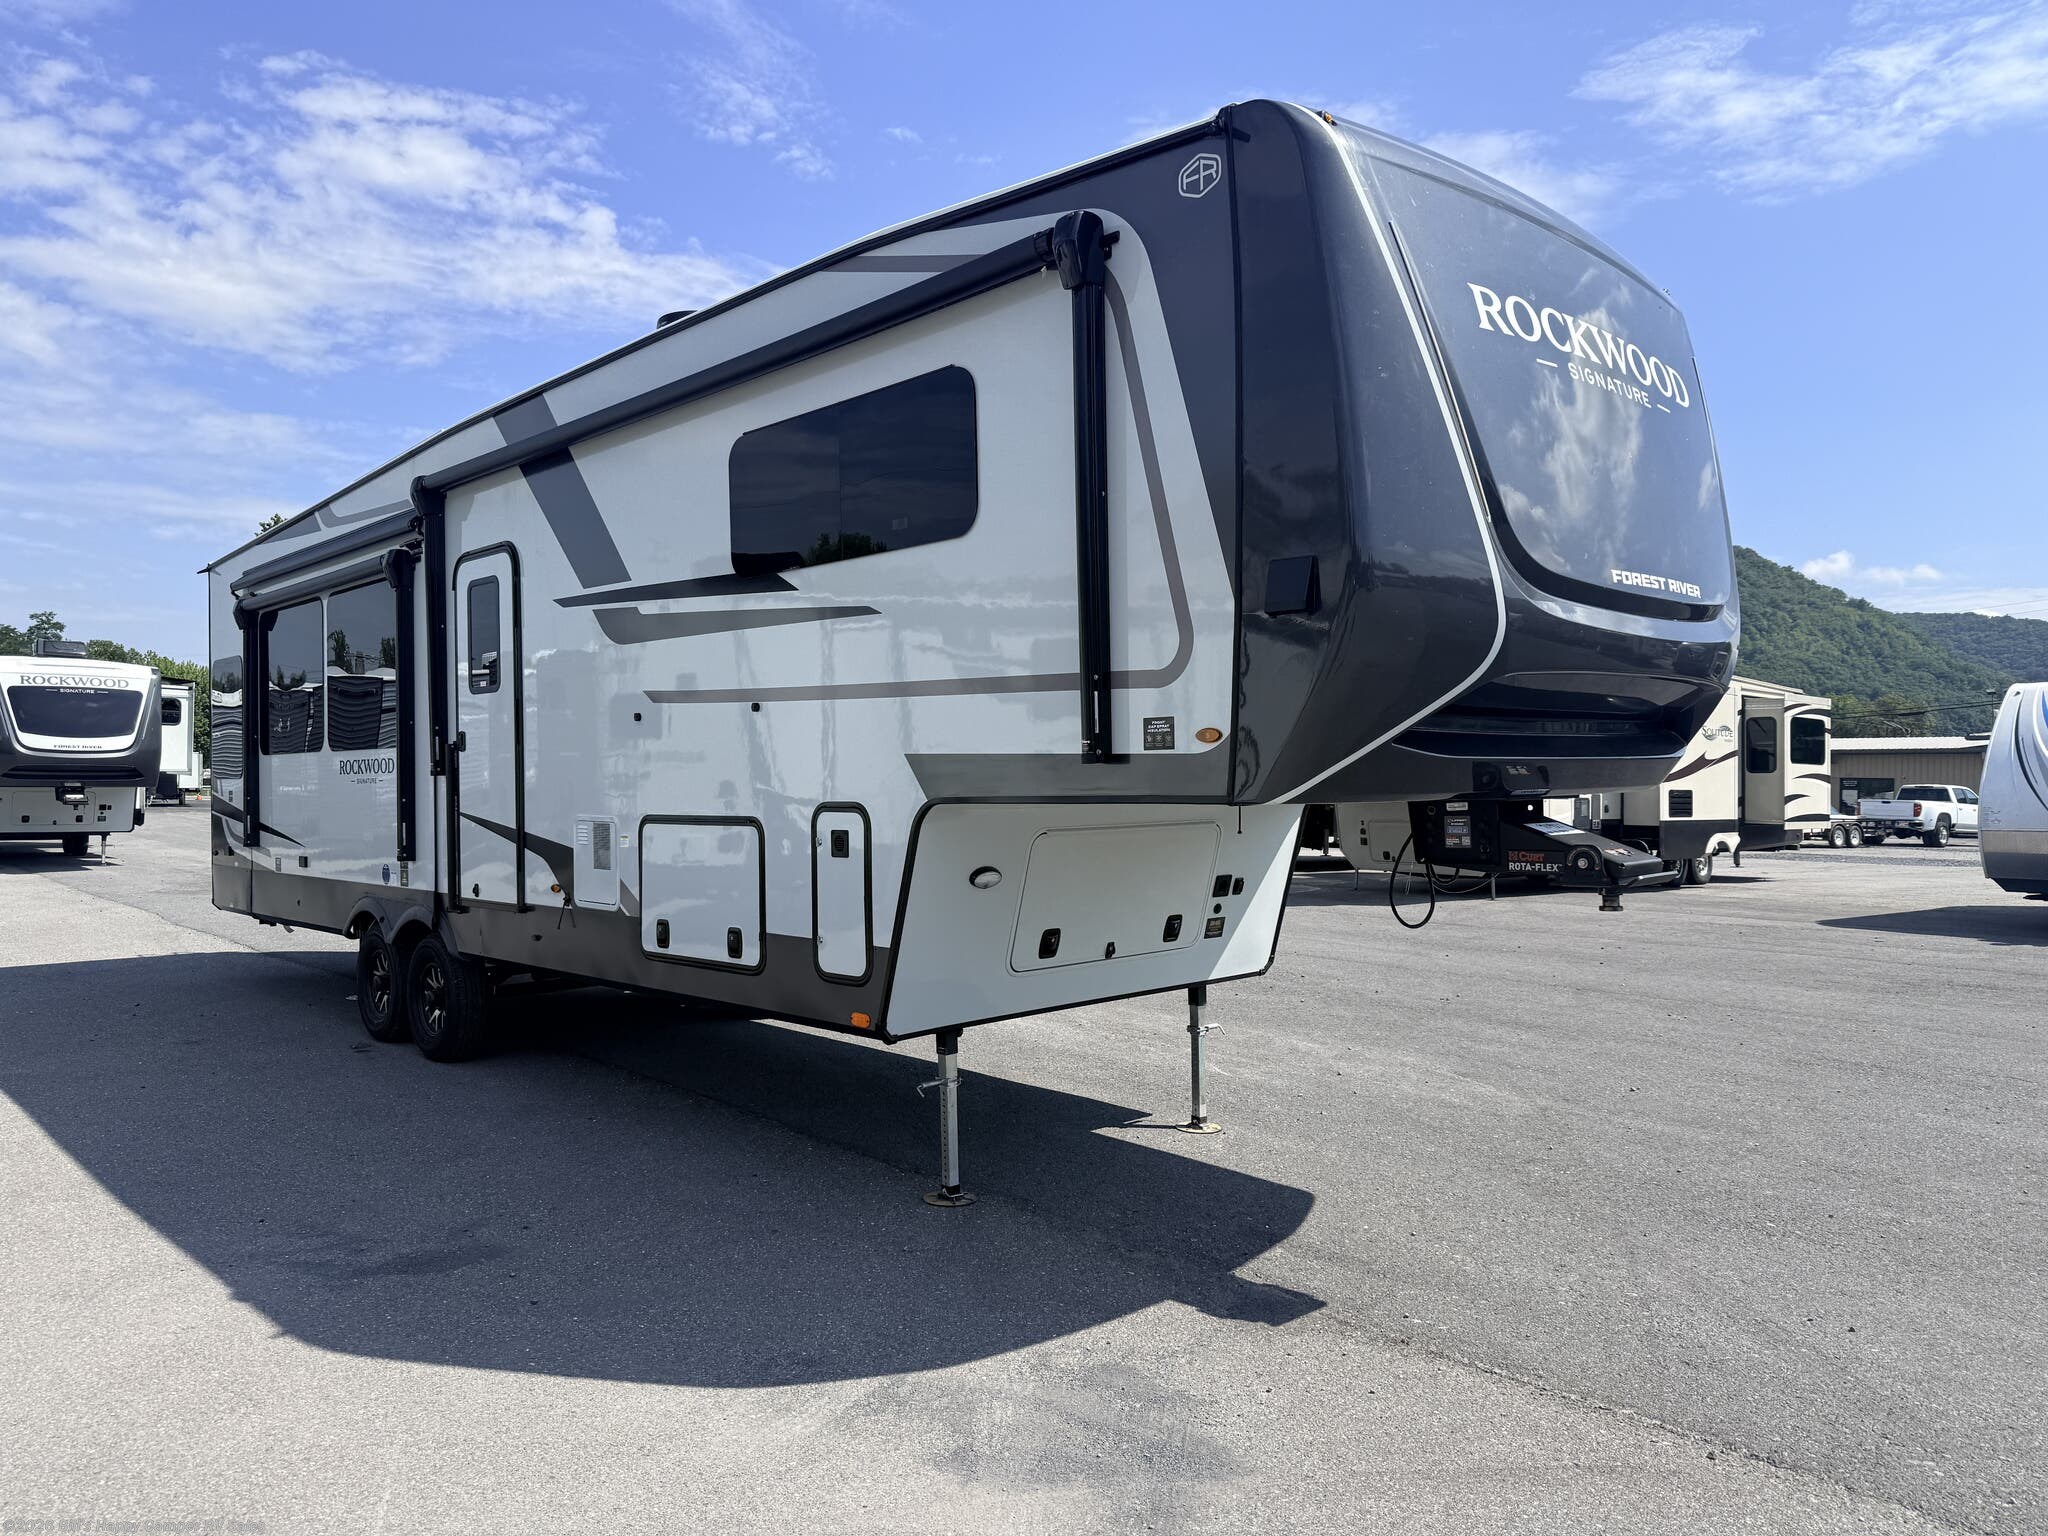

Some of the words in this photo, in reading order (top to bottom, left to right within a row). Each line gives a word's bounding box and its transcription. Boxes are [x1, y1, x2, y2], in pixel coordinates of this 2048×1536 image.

[1466, 281, 1690, 409] ROCKWOOD
[1567, 361, 1653, 409] SIGNATURE
[1610, 569, 1666, 590] FOREST
[1667, 578, 1701, 599] RIVER
[19, 674, 130, 689] ROCKWOOD
[339, 758, 395, 775] ROCKWOOD
